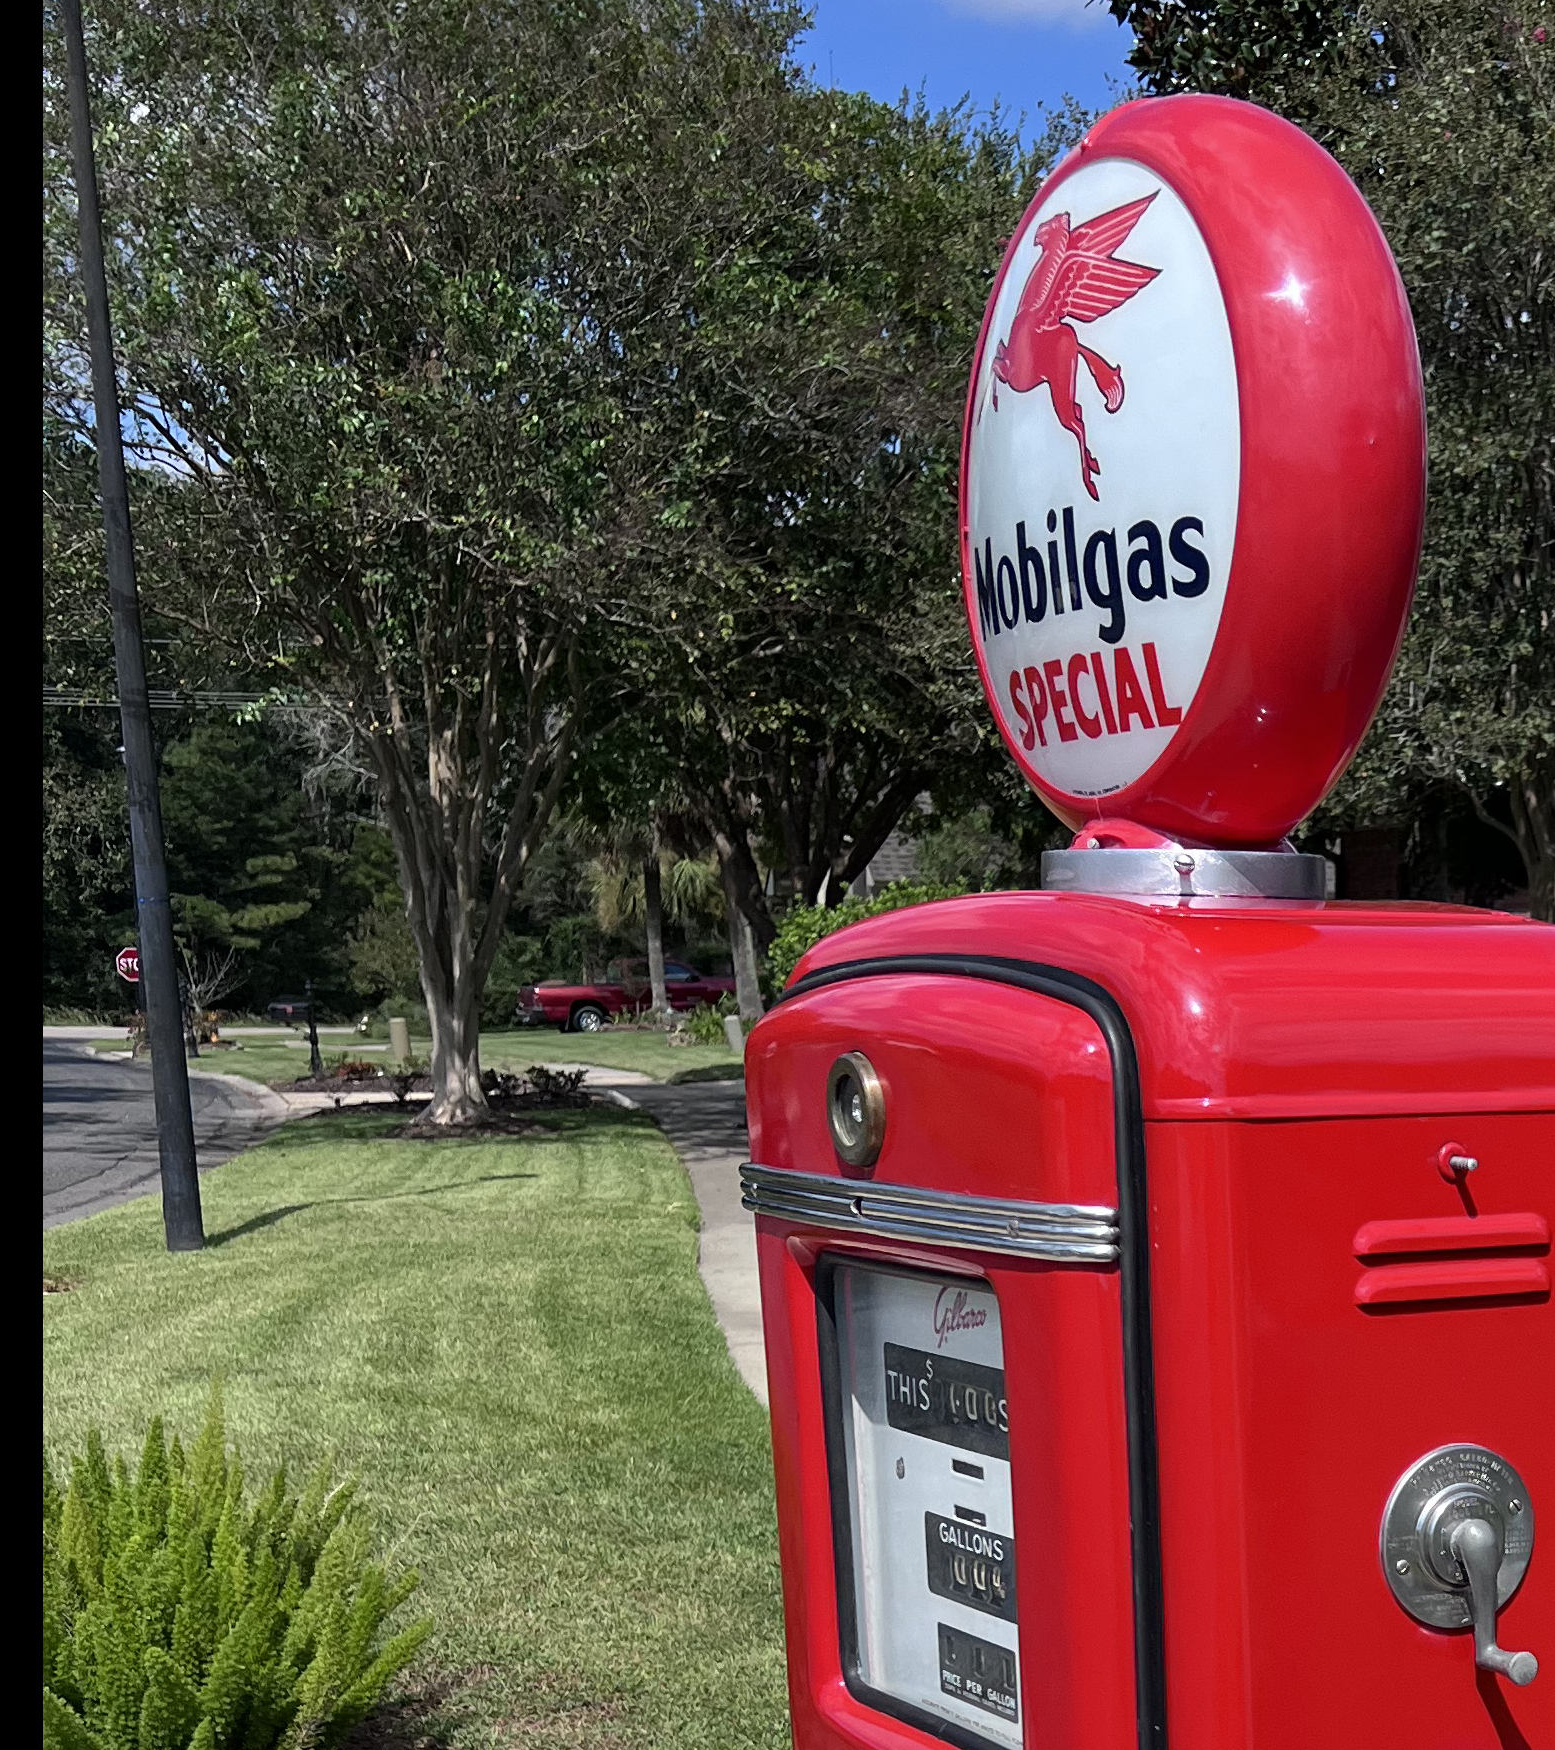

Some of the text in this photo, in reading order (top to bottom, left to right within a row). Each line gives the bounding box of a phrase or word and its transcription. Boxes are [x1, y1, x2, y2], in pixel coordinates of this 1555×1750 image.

[974, 506, 1210, 644] Mobilgas
[1009, 642, 1183, 751] SPECIAL
[120, 957, 139, 972] STO
[887, 1369, 931, 1412] THIS
[939, 1522, 1004, 1562] GALLONS
[966, 1679, 983, 1696] PER
[987, 1688, 1016, 1710] GALLON
